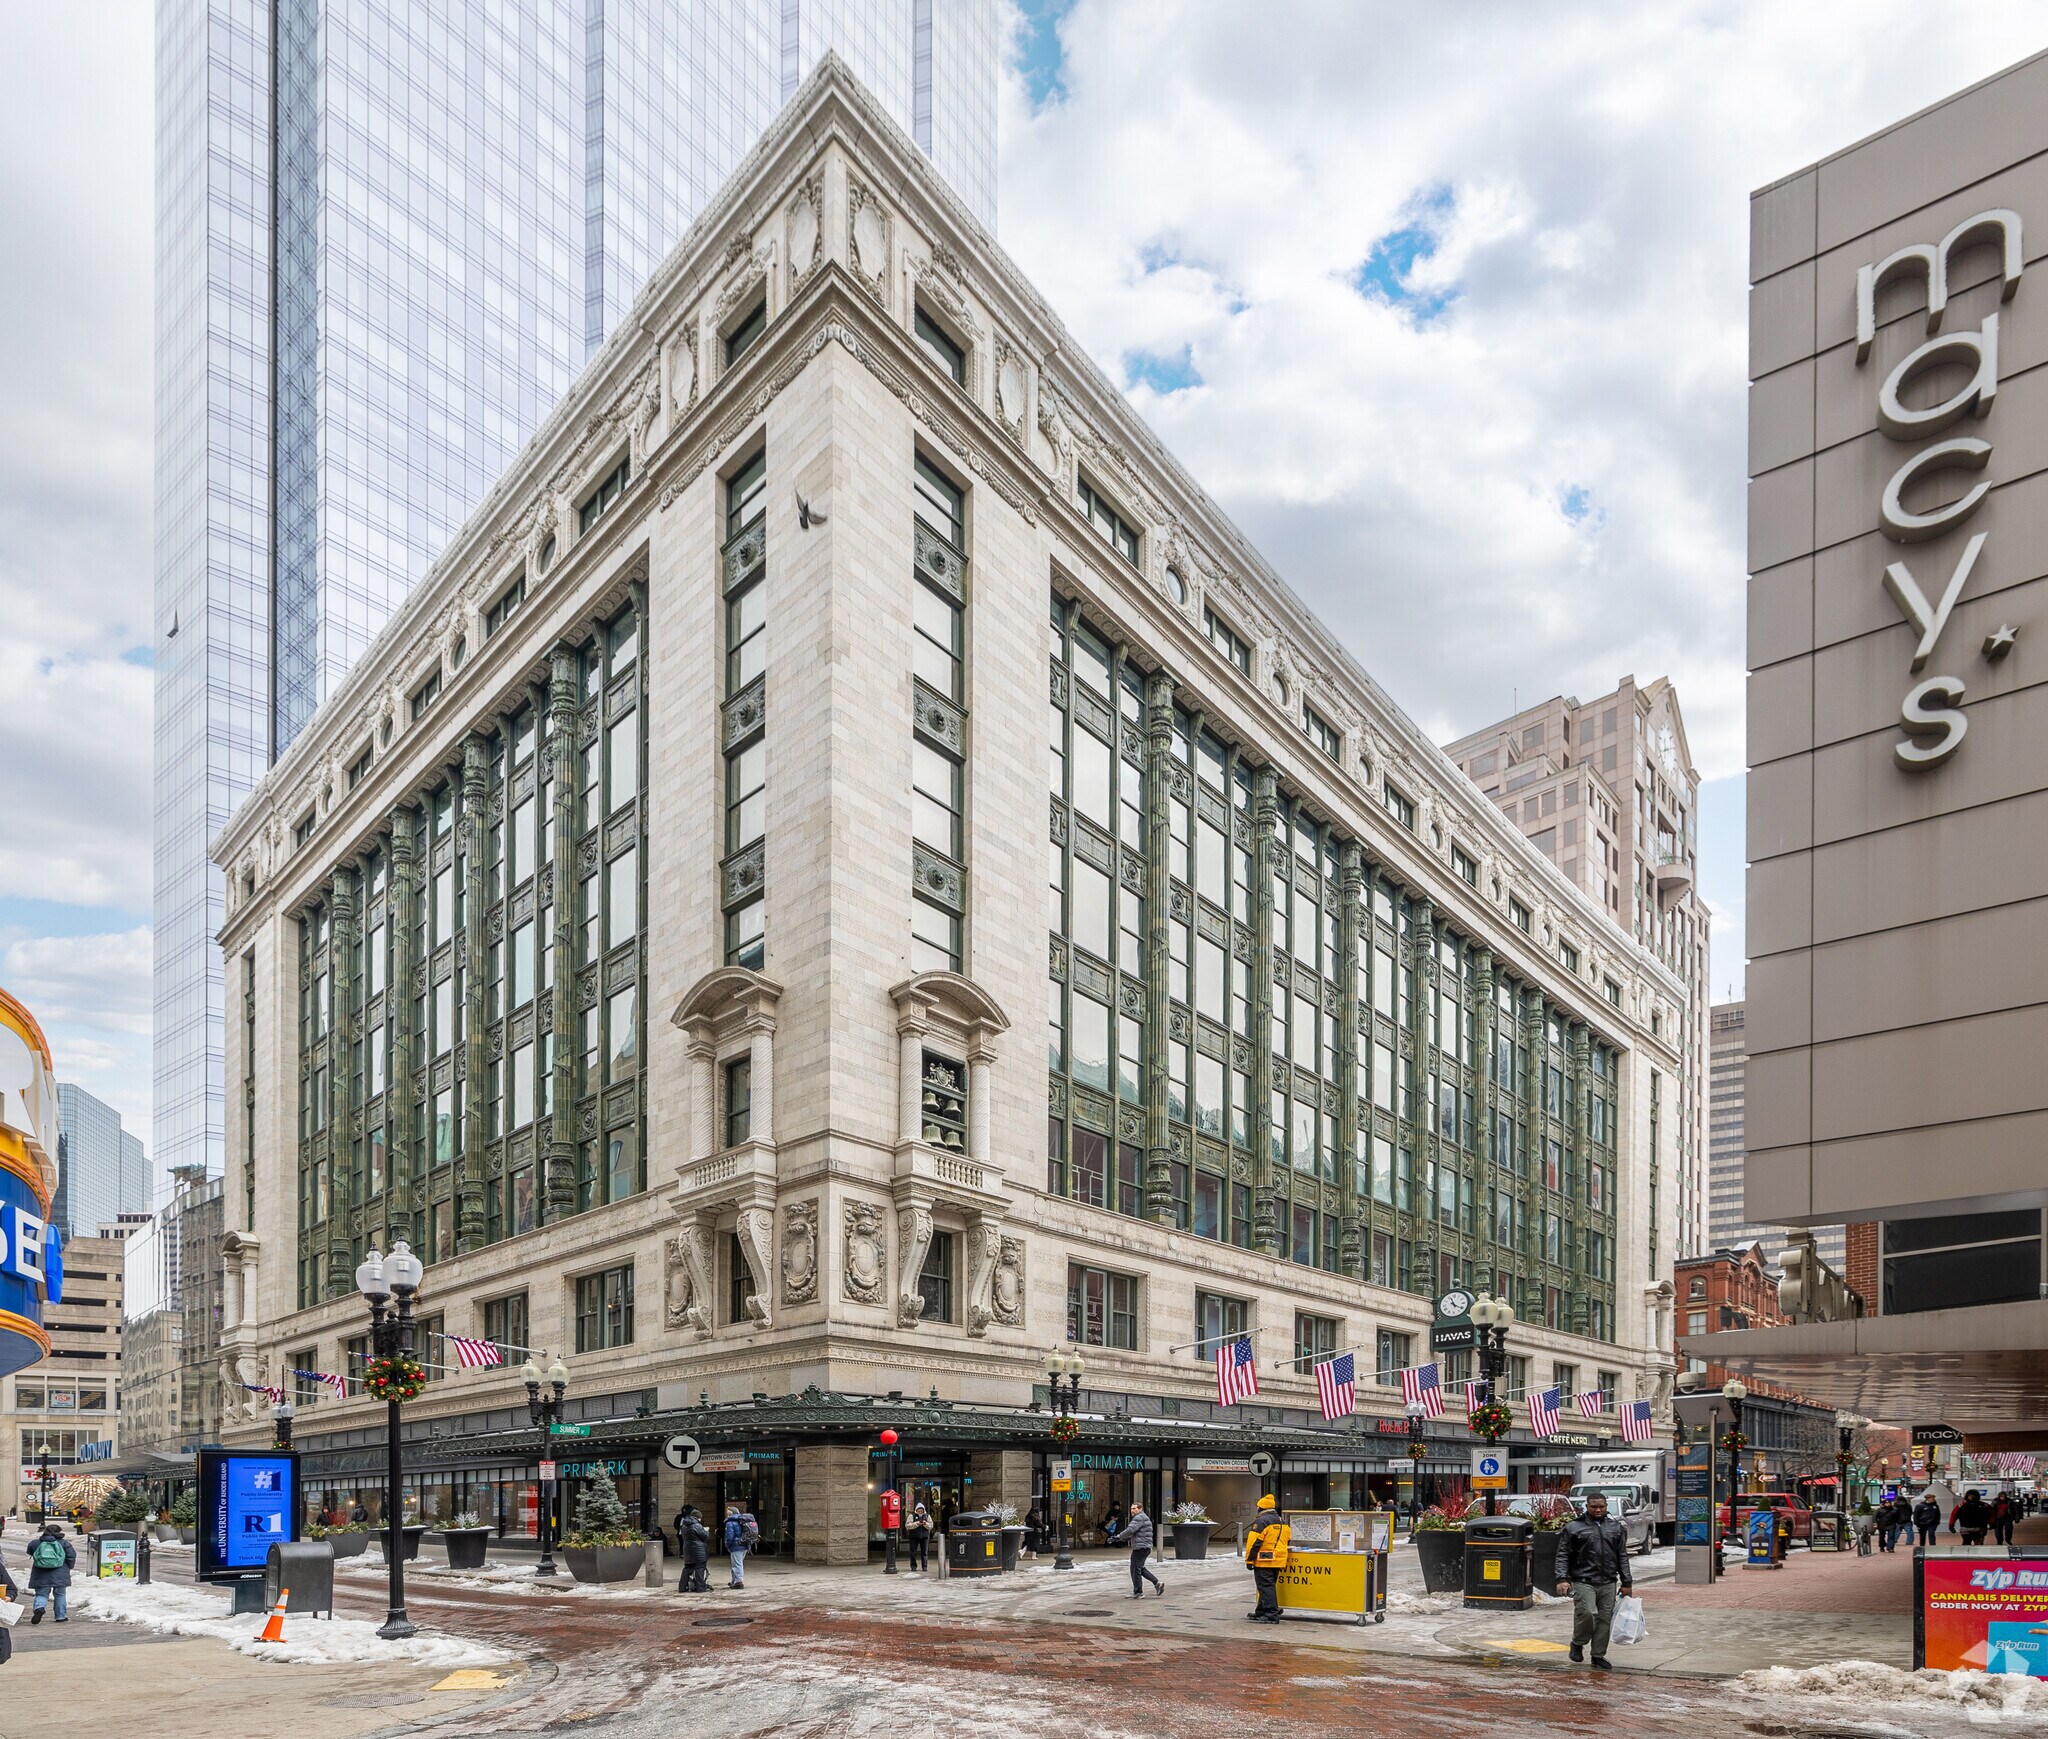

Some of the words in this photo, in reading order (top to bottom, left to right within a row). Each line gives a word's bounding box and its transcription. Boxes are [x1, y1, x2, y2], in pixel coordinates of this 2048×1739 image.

[1435, 1331, 1471, 1342] HAVAS
[559, 1425, 580, 1434] SUMMER
[1379, 1419, 1403, 1433] Roche
[1570, 1436, 1588, 1445] NERO
[80, 1443, 94, 1463] OLD
[93, 1440, 113, 1462] NAVY
[1071, 1454, 1145, 1470] PRIMARK
[562, 1460, 628, 1478] PRIMRK
[1587, 1464, 1650, 1473] PENSKE
[254, 1470, 284, 1492] #1
[1059, 1491, 1091, 1501] SON
[218, 1504, 227, 1547] UNIVERSITY
[242, 1512, 284, 1533] R1
[1278, 1565, 1331, 1575] WNTOWN
[1278, 1576, 1313, 1586] STON.
[1970, 1567, 2015, 1591] Zyp
[1930, 1593, 1997, 1602] CANNABIS
[1930, 1602, 1969, 1610] ORDER
[1971, 1603, 2003, 1611] NOW
[2023, 1604, 2048, 1612] ZYP
[1995, 1640, 2017, 1651] Zyp
[2017, 1641, 2040, 1650] Run
